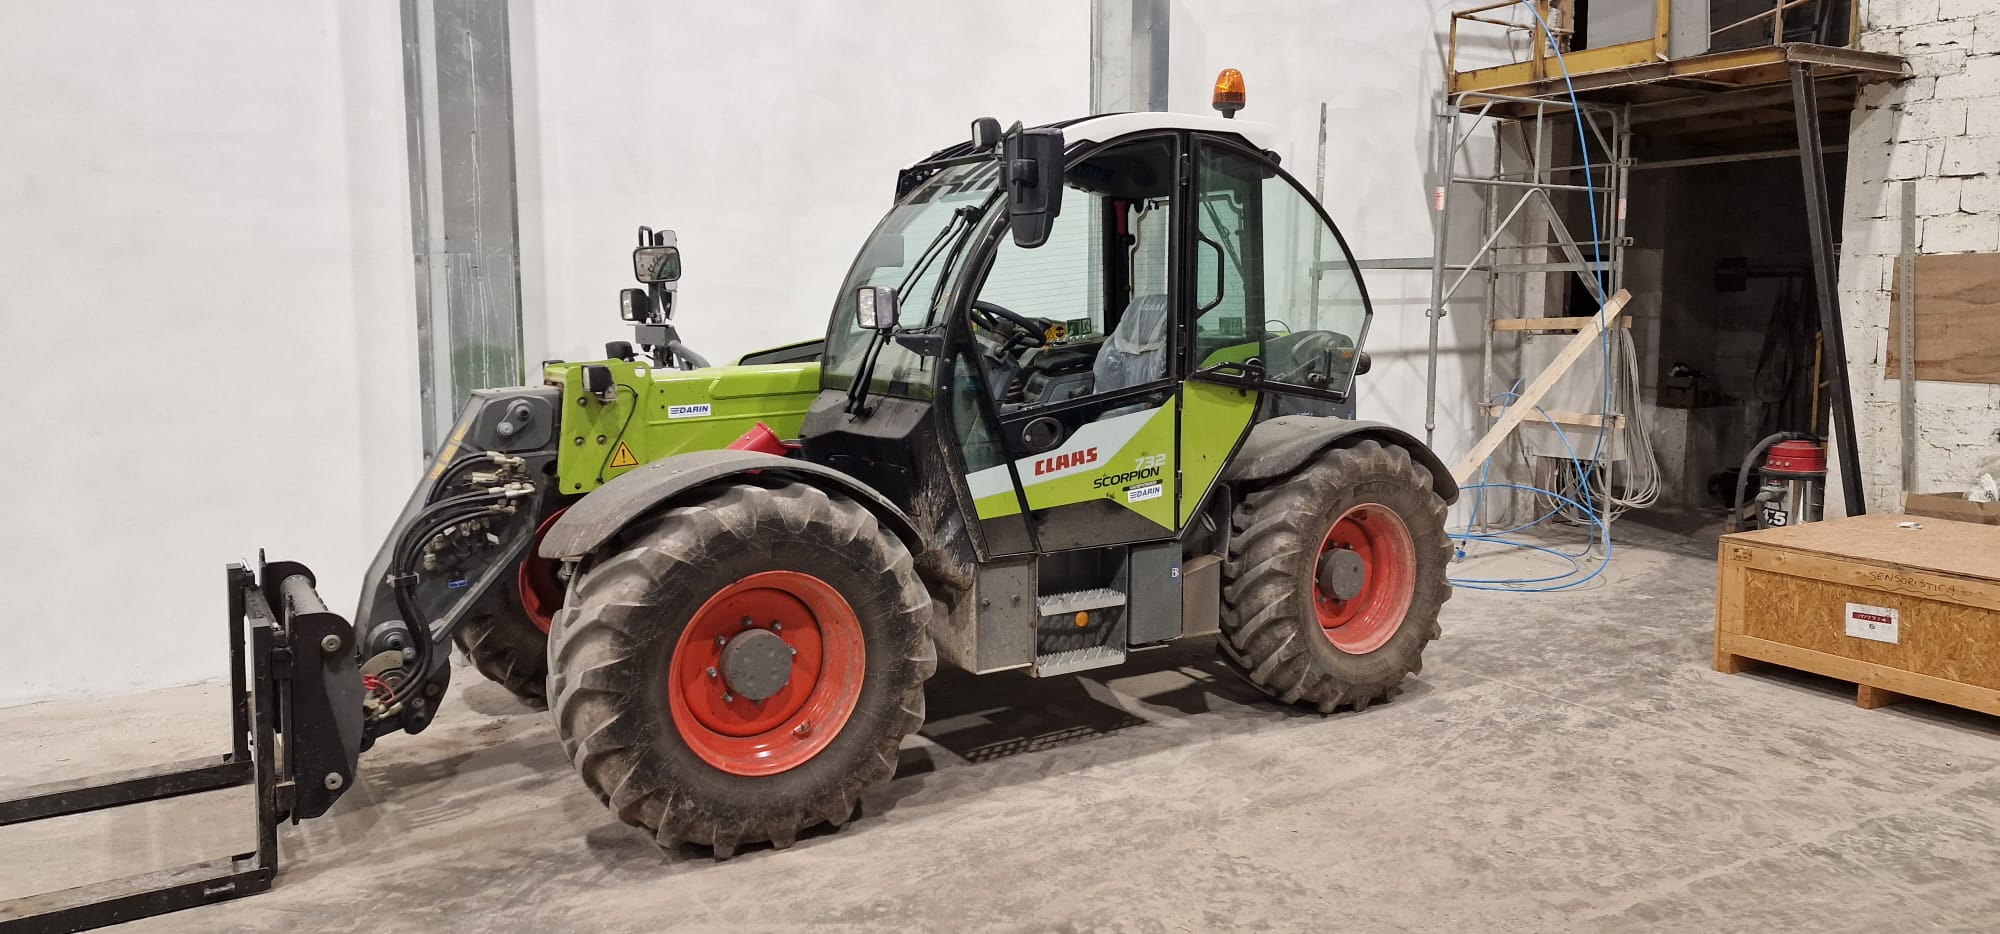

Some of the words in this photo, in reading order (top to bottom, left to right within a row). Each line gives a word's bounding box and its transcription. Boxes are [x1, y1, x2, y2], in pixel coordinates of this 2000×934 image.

[680, 405, 709, 414] DARIN
[1034, 446, 1098, 476] CLAAS
[1135, 453, 1167, 471] 732
[1093, 466, 1160, 489] SCORPION
[1136, 486, 1161, 498] DARIN
[1869, 571, 1956, 593] SENSORISTICA
